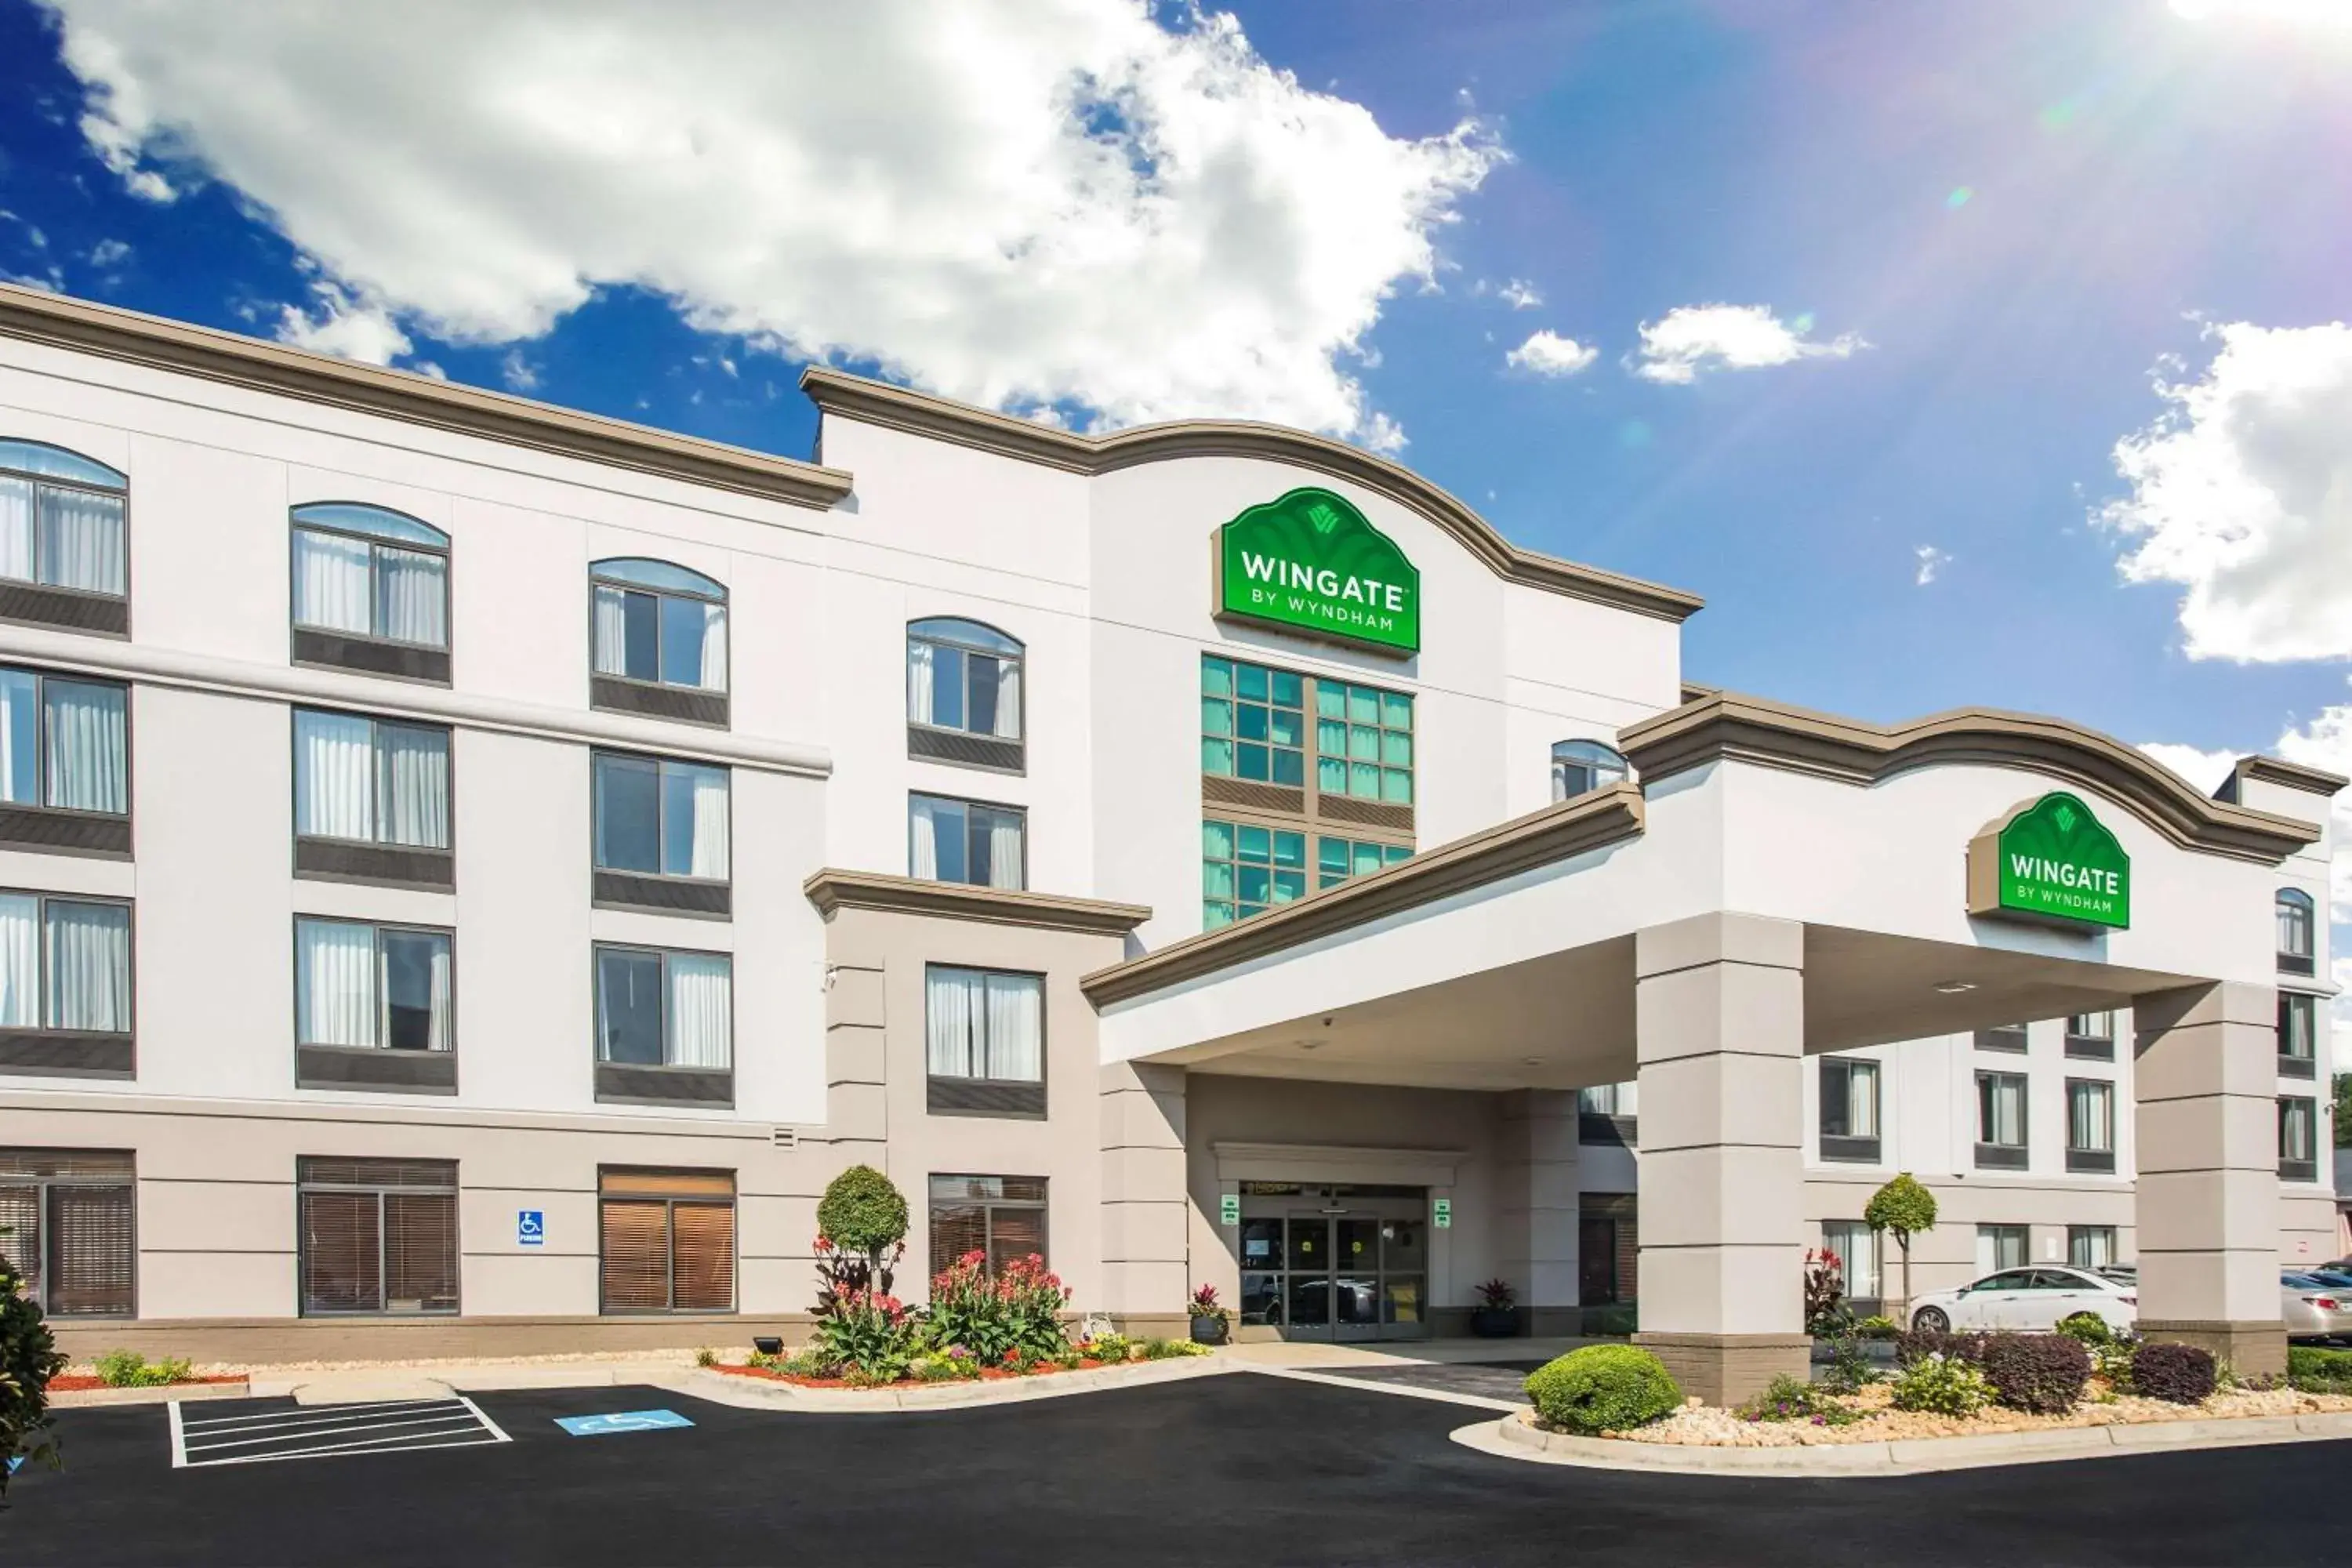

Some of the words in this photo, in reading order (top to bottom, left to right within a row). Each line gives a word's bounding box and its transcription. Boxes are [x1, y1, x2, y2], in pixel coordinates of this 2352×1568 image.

[1241, 550, 1403, 612] WINGATE
[1251, 588, 1277, 607] BY
[1288, 595, 1393, 632] WYNDHAM
[2010, 852, 2119, 895] WINGATE
[2017, 885, 2035, 899] BY
[2041, 890, 2112, 913] WYNDHAM
